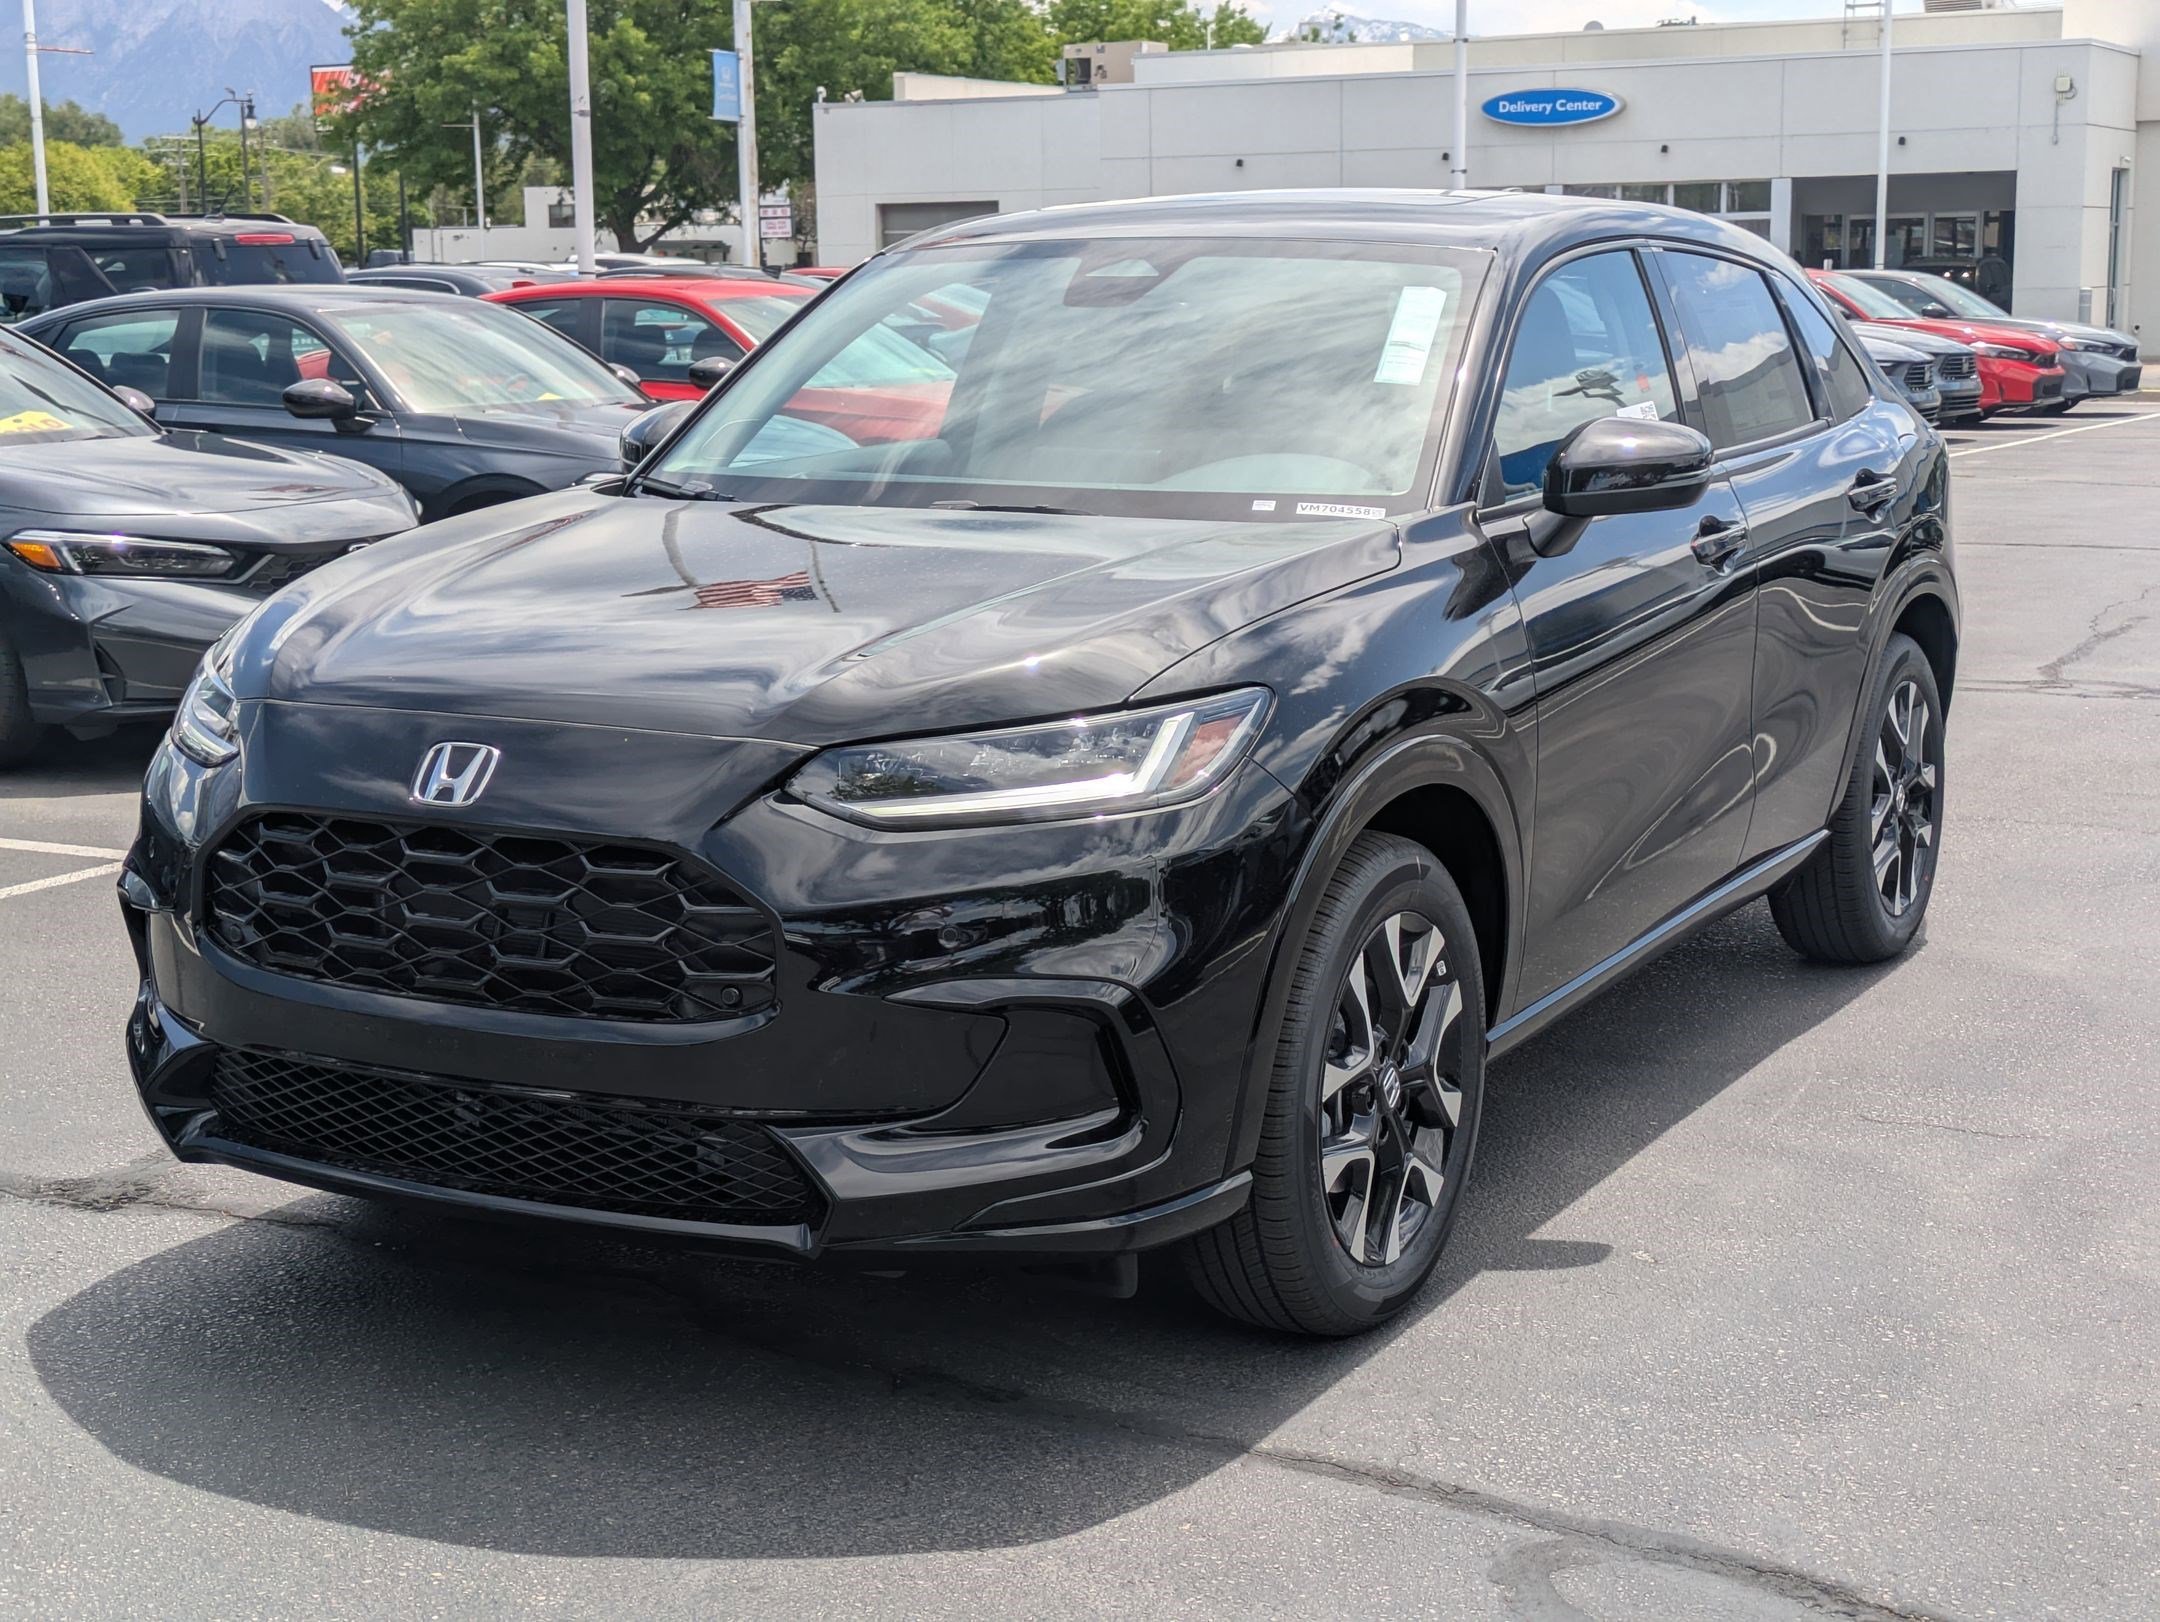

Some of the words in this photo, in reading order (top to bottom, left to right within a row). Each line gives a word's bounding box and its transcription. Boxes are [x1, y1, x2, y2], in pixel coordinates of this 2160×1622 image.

[1498, 100, 1552, 115] Delivery
[1555, 99, 1603, 111] Center
[1299, 503, 1372, 516] VM704558
